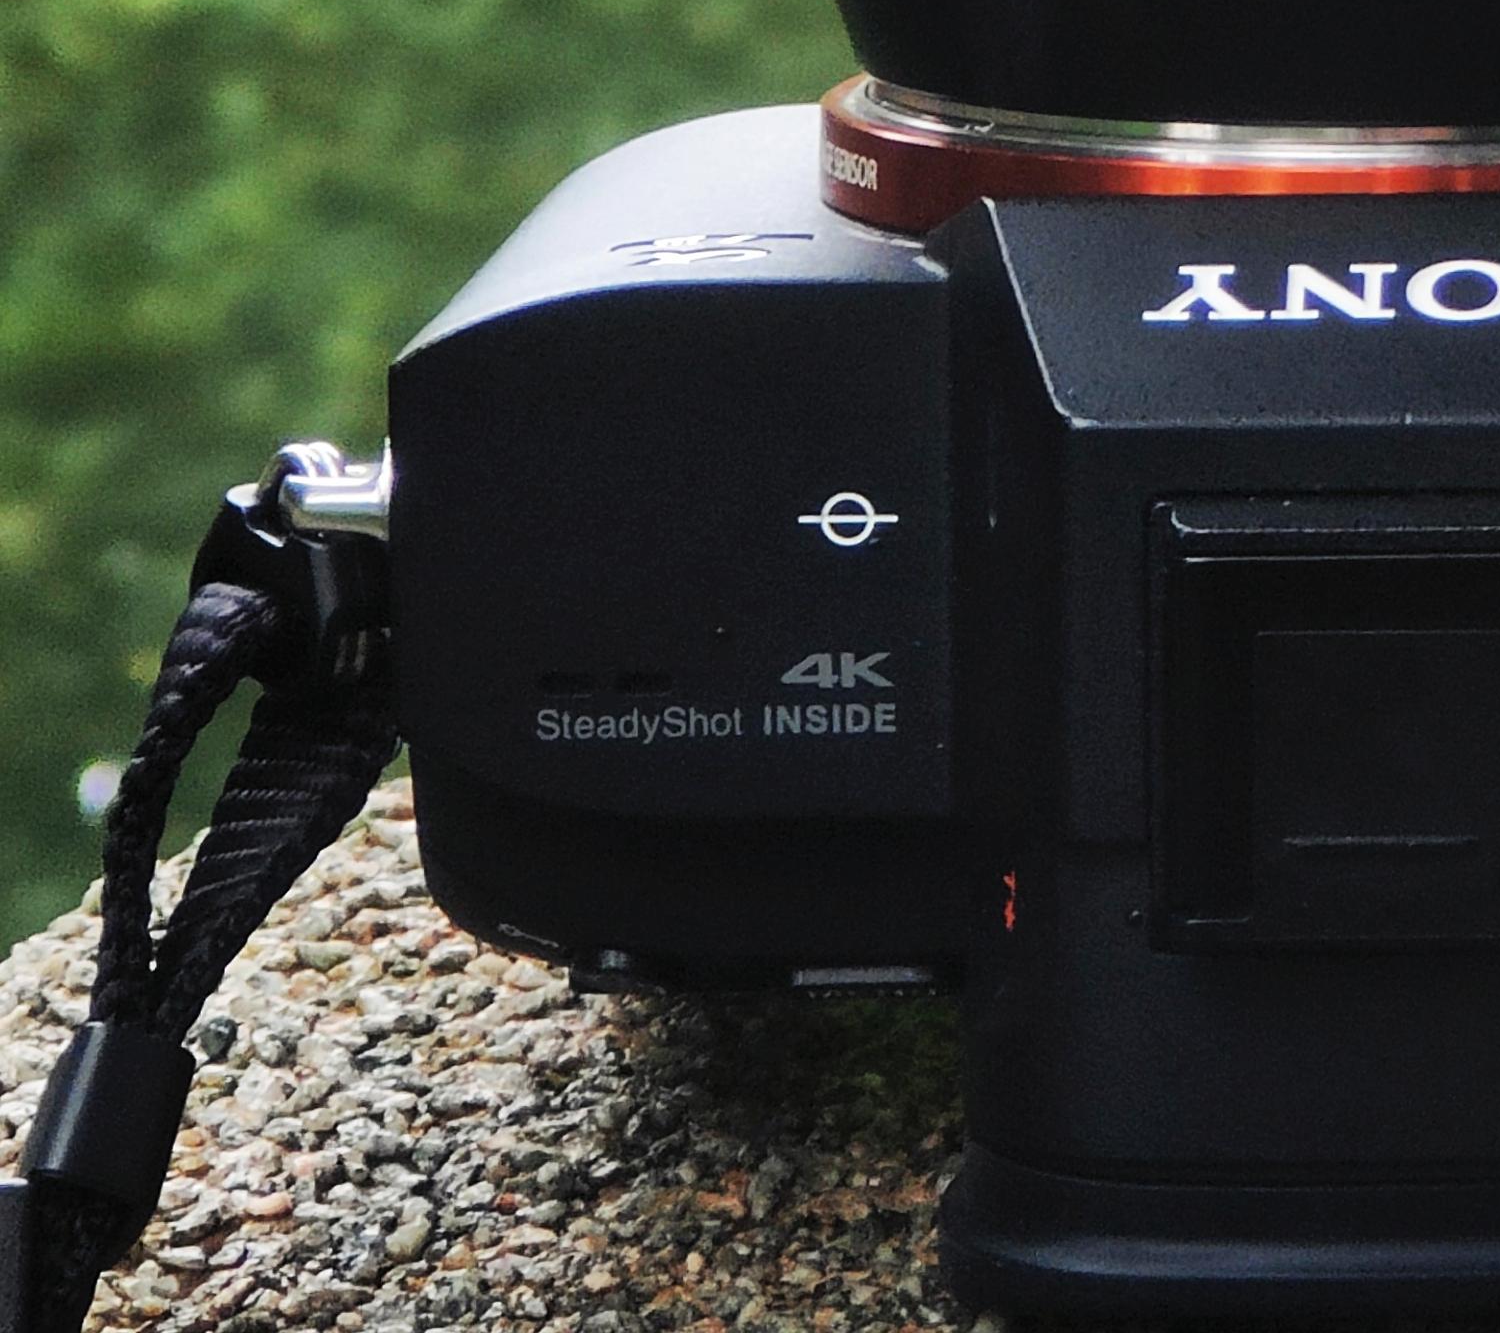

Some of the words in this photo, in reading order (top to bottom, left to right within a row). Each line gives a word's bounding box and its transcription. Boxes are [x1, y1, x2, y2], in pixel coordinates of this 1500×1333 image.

[780, 651, 895, 689] 4K
[536, 705, 744, 745] SteadyShot
[763, 702, 897, 736] INSIDE
